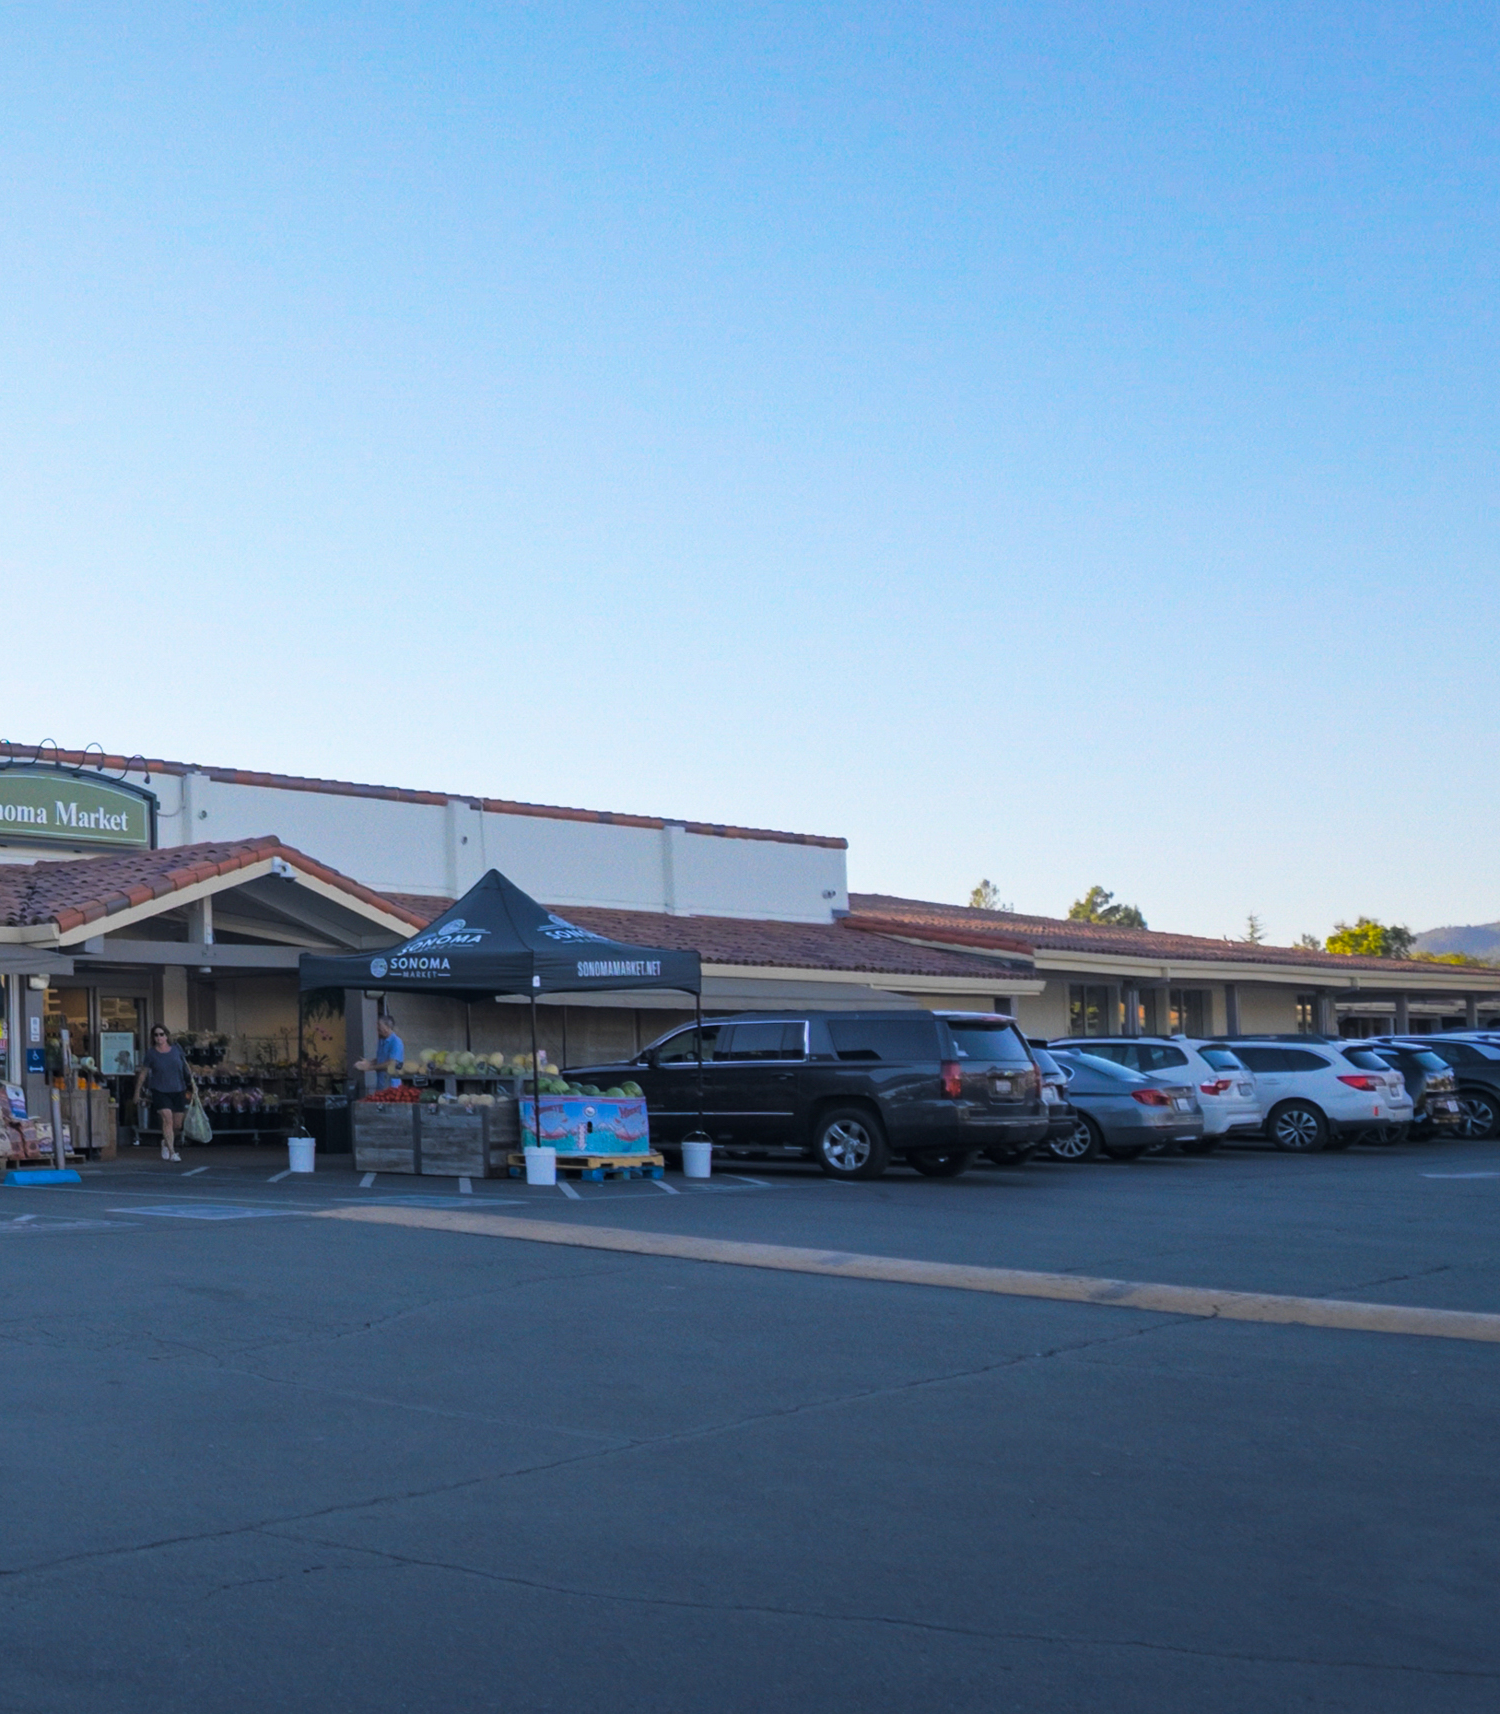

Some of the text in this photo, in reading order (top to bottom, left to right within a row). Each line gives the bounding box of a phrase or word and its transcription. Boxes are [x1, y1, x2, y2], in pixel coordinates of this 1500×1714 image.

[55, 800, 129, 832] Market
[396, 934, 483, 956] SONOMA
[390, 957, 451, 970] SONOMA
[577, 960, 661, 978] SONOMAMARKET.NET
[402, 971, 438, 979] MARKET
